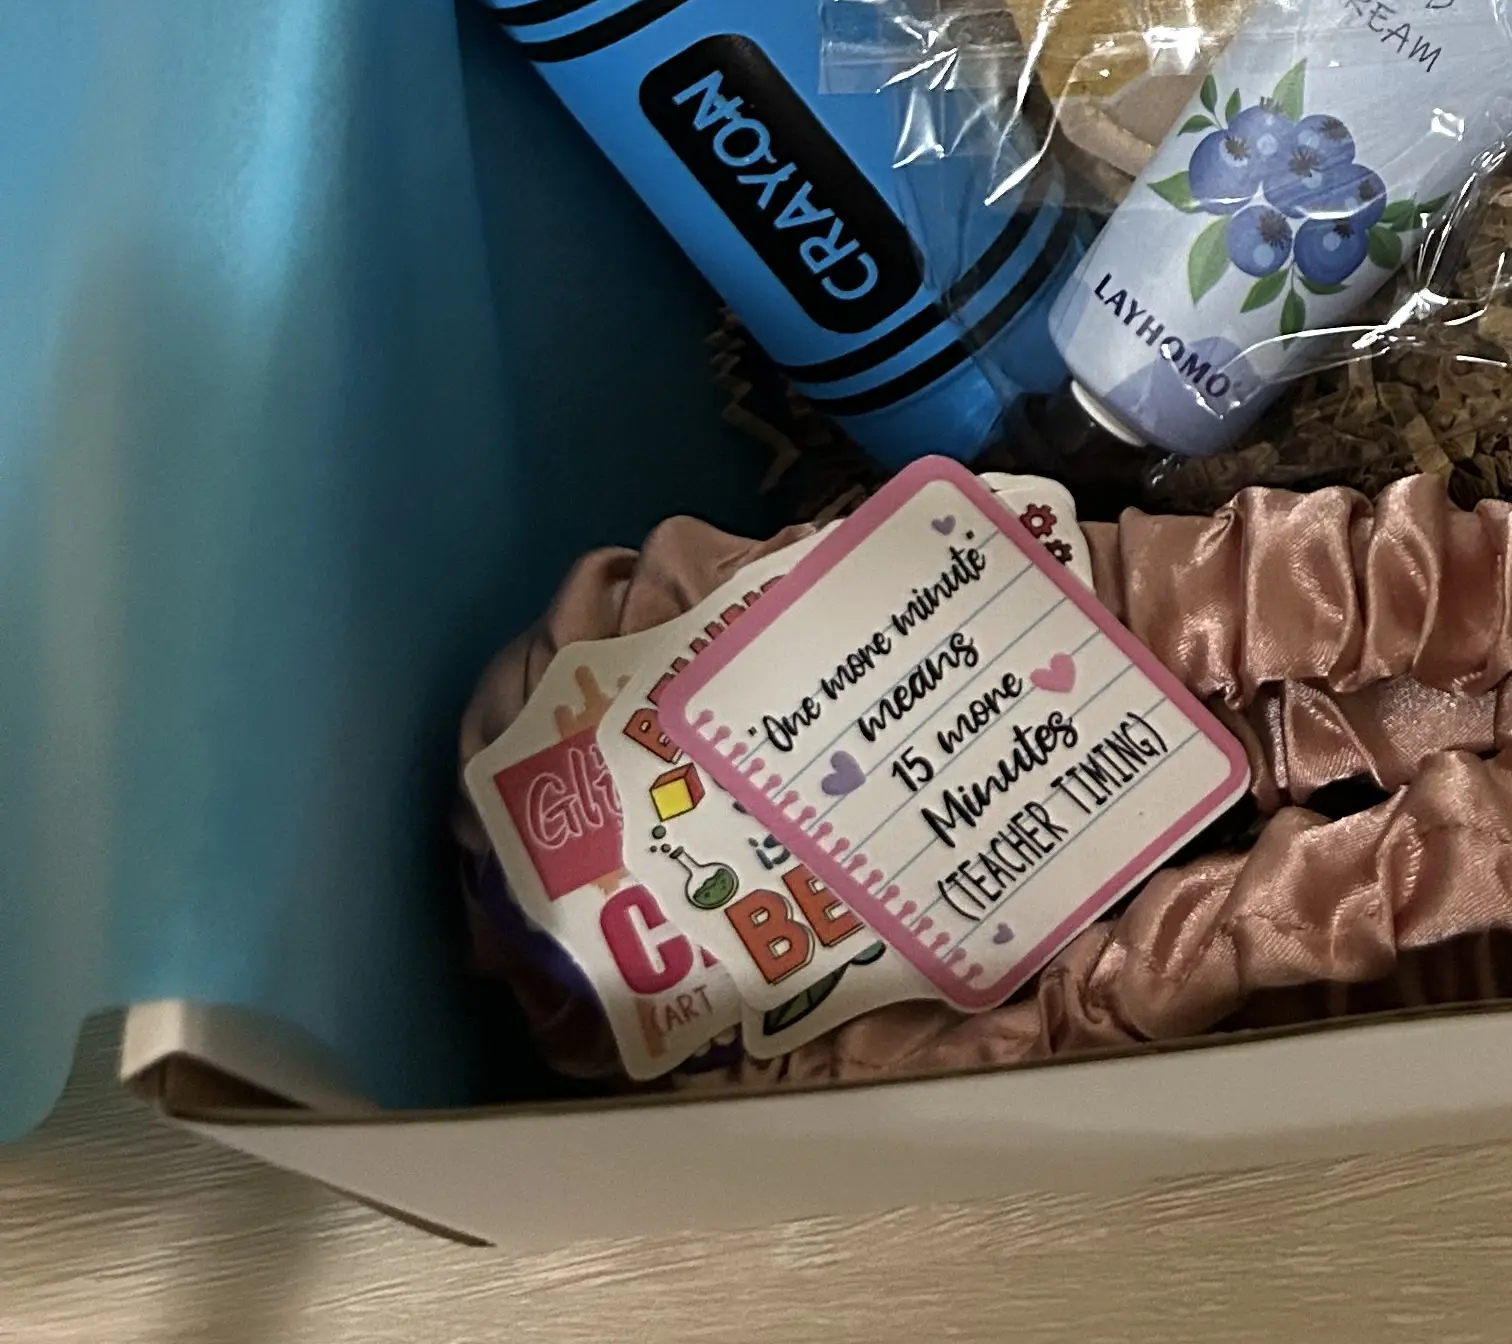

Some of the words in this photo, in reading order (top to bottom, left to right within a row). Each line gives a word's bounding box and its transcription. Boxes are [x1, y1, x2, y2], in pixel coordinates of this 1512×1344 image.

[672, 70, 879, 301] CRAYON
[1094, 272, 1231, 398] LAYHOMO
[821, 631, 892, 700] more
[857, 631, 979, 743] means
[891, 745, 935, 793] 15
[937, 672, 1023, 754] more
[921, 710, 1079, 849] Minutes
[937, 800, 1069, 921] (TEACHER
[1050, 711, 1168, 815] TIMING)
